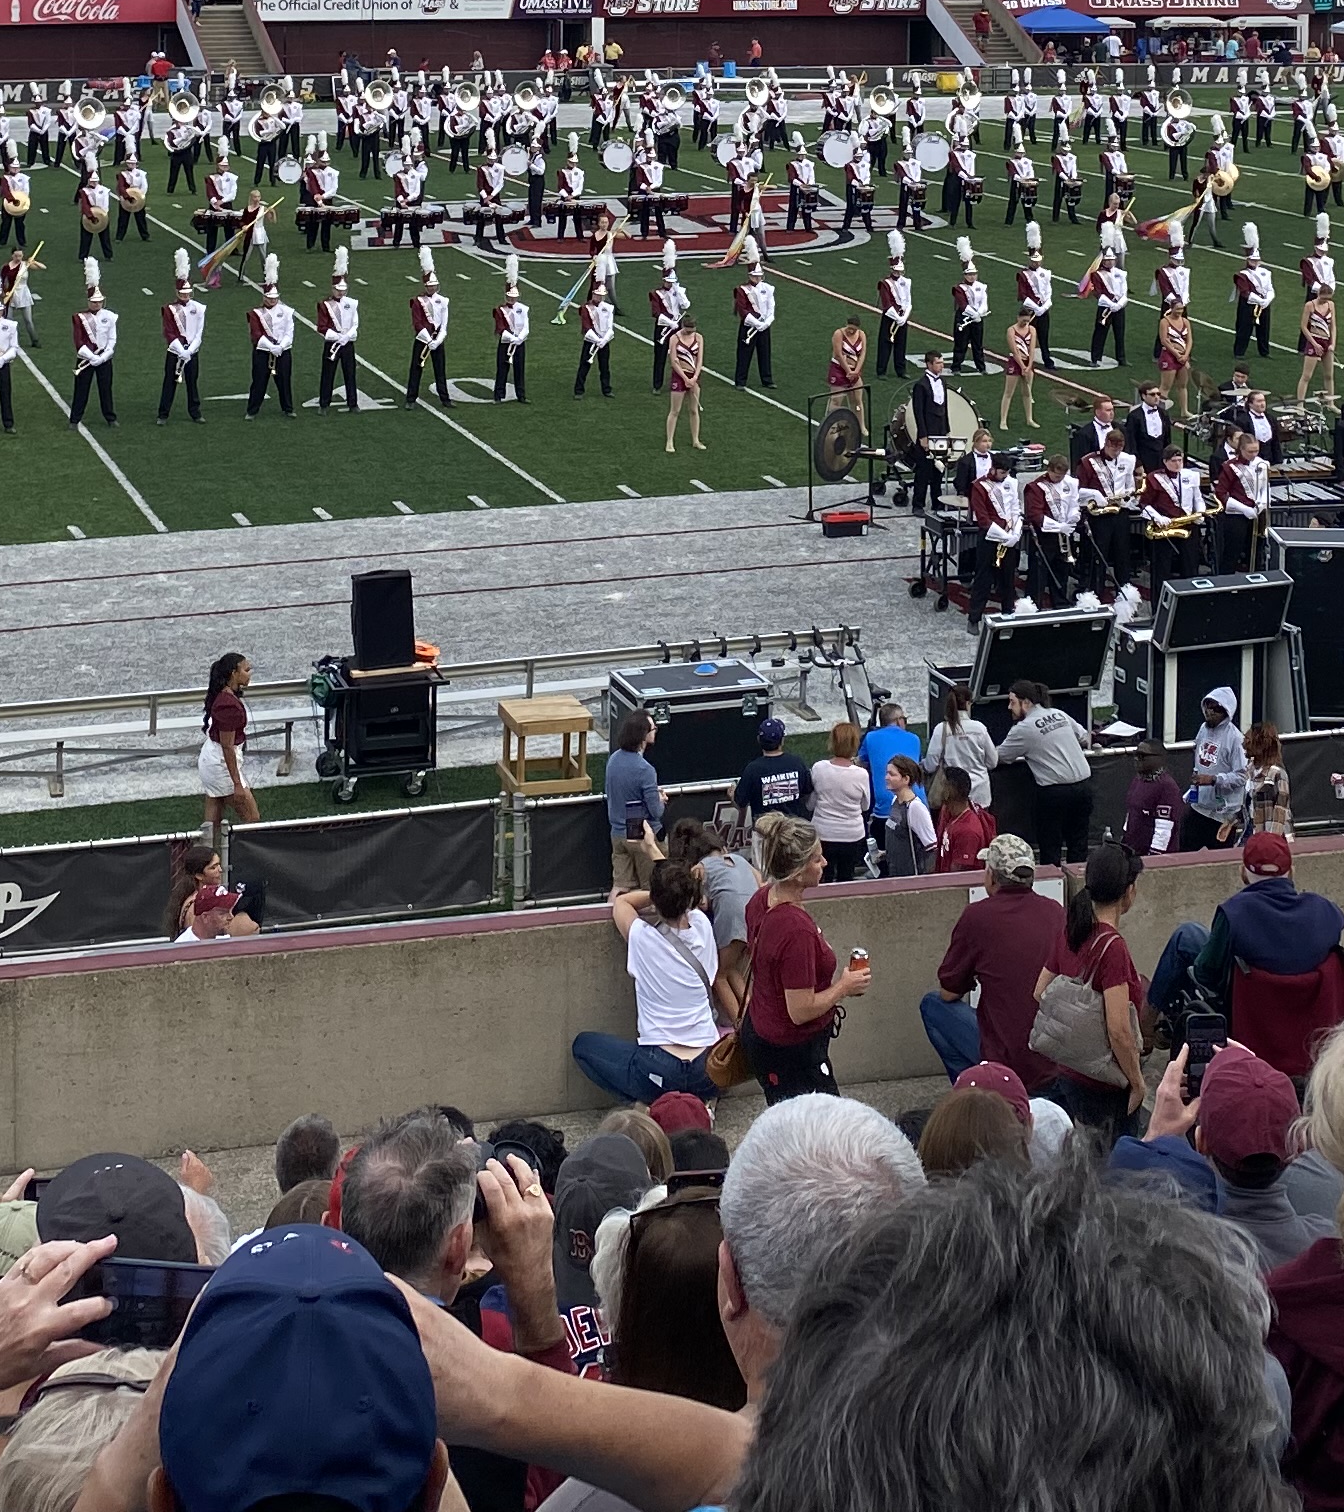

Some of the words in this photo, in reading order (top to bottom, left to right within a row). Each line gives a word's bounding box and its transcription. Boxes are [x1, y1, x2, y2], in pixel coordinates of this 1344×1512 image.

[253, 0, 275, 10] The
[761, 770, 799, 785] WAIKIKI
[762, 795, 794, 807] STATION
